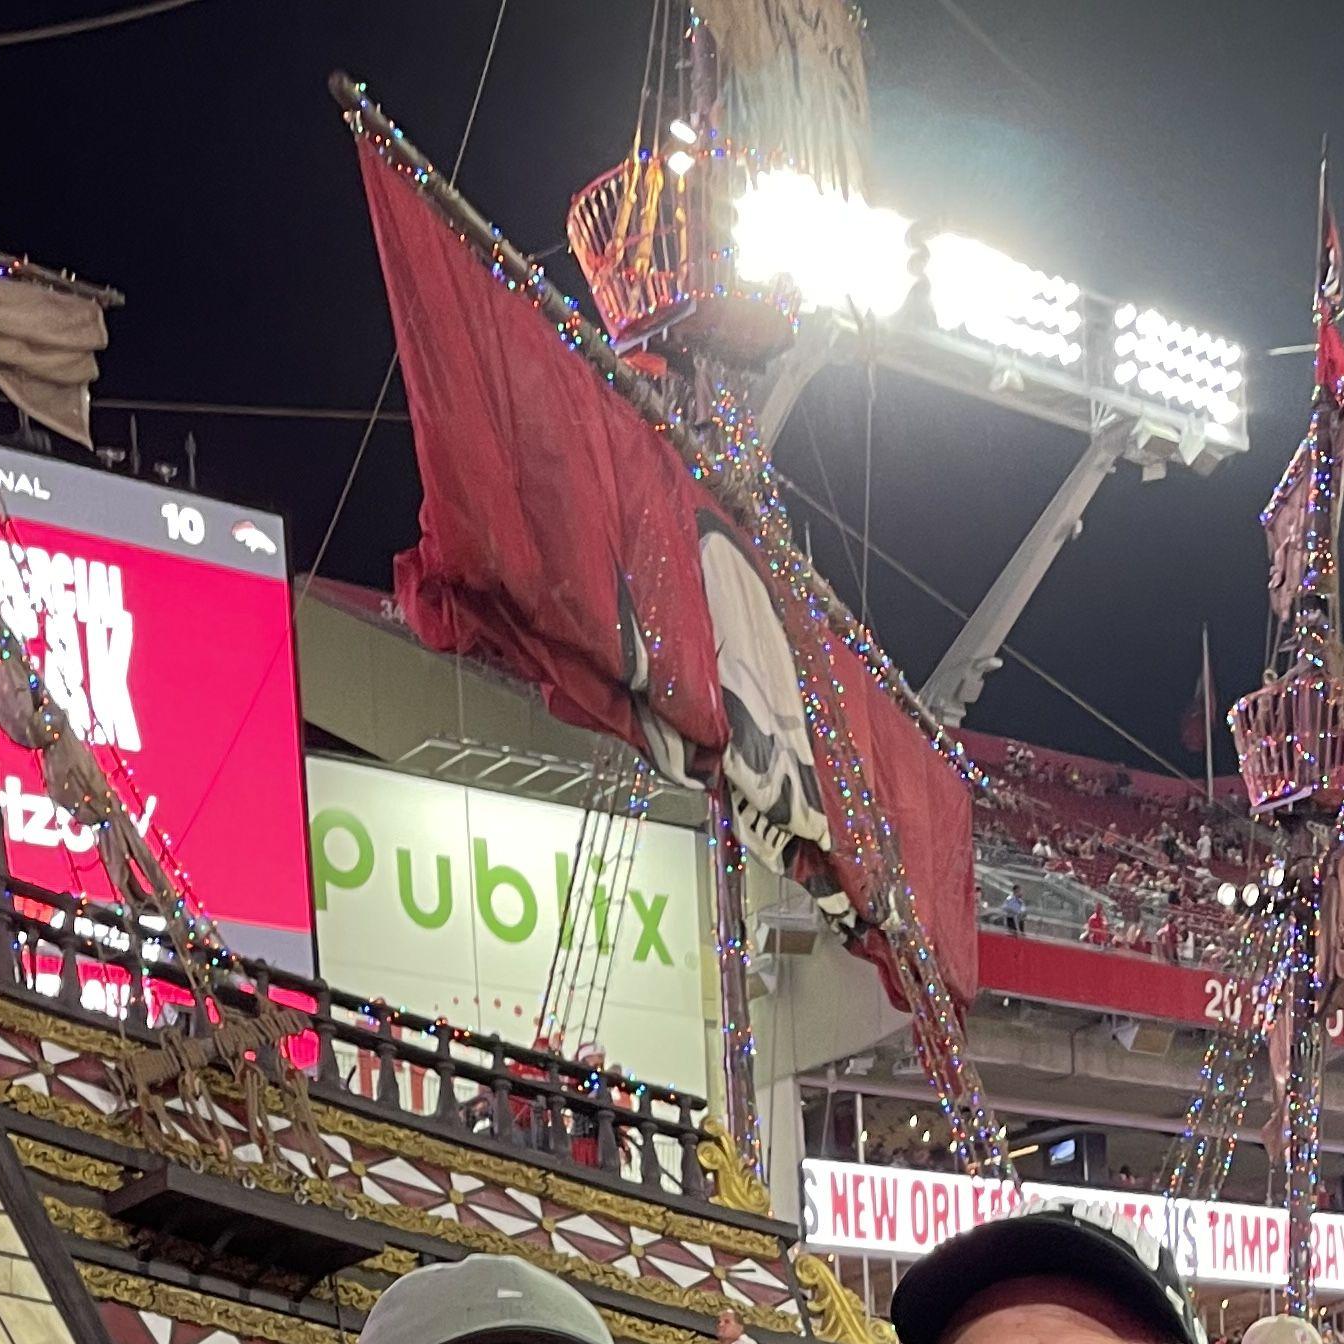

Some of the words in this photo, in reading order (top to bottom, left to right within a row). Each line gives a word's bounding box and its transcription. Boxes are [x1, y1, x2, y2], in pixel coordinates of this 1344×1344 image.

[161, 503, 205, 545] 10
[380, 599, 406, 624] 34
[311, 807, 674, 966] Publix
[830, 1171, 898, 1241] NEW
[1208, 1211, 1292, 1275] TAMP
